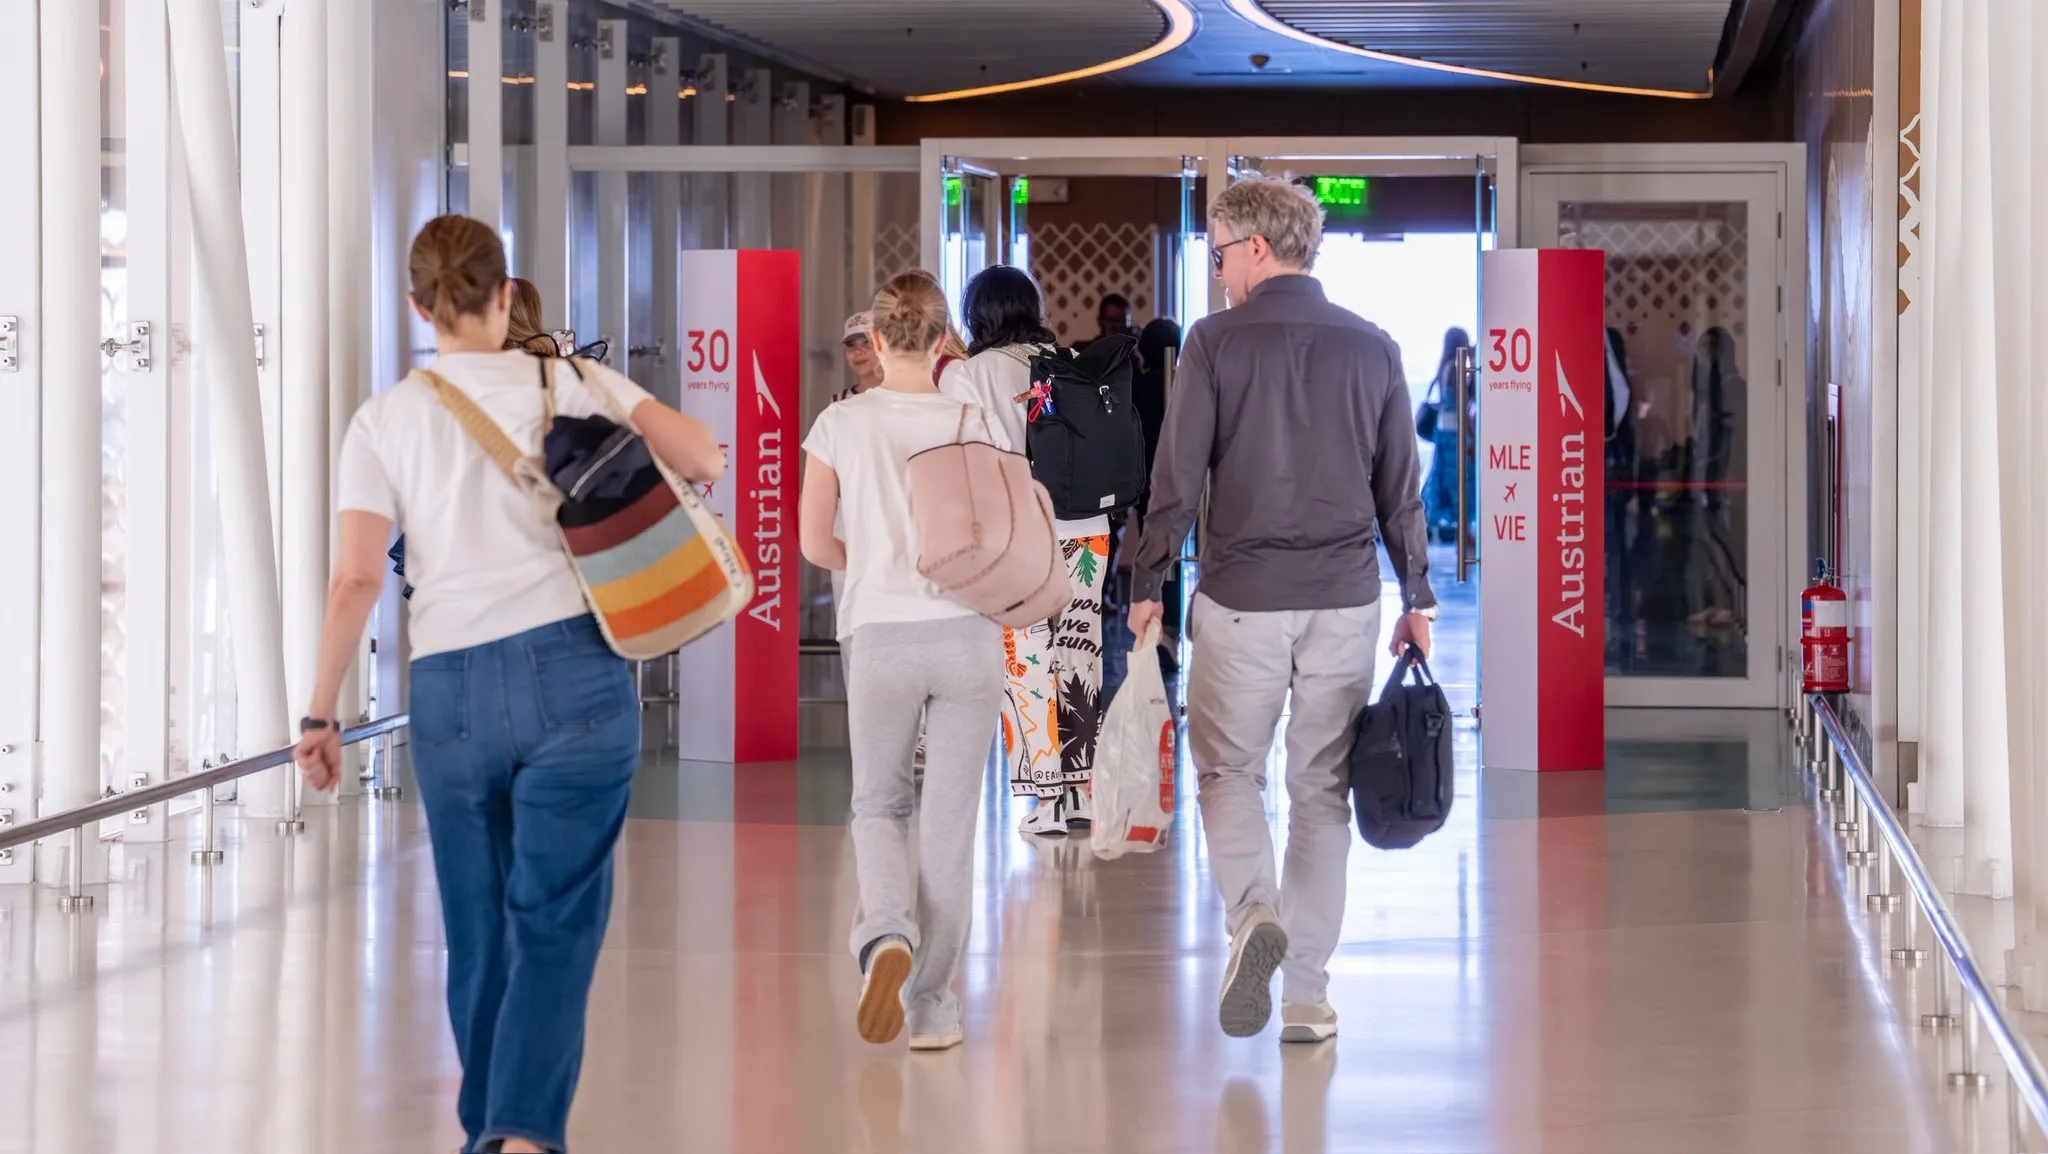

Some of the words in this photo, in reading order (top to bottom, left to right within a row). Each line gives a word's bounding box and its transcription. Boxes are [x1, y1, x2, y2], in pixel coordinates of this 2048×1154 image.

[687, 329, 729, 373] 30
[1488, 328, 1532, 373] 30
[687, 381, 707, 391] years
[709, 379, 730, 392] flying
[1489, 381, 1509, 391] years
[1511, 379, 1532, 392] flying
[1489, 445, 1532, 471] MLE
[749, 429, 781, 631] Austrian
[1494, 515, 1526, 541] VIE
[1552, 431, 1585, 638] Austrian
